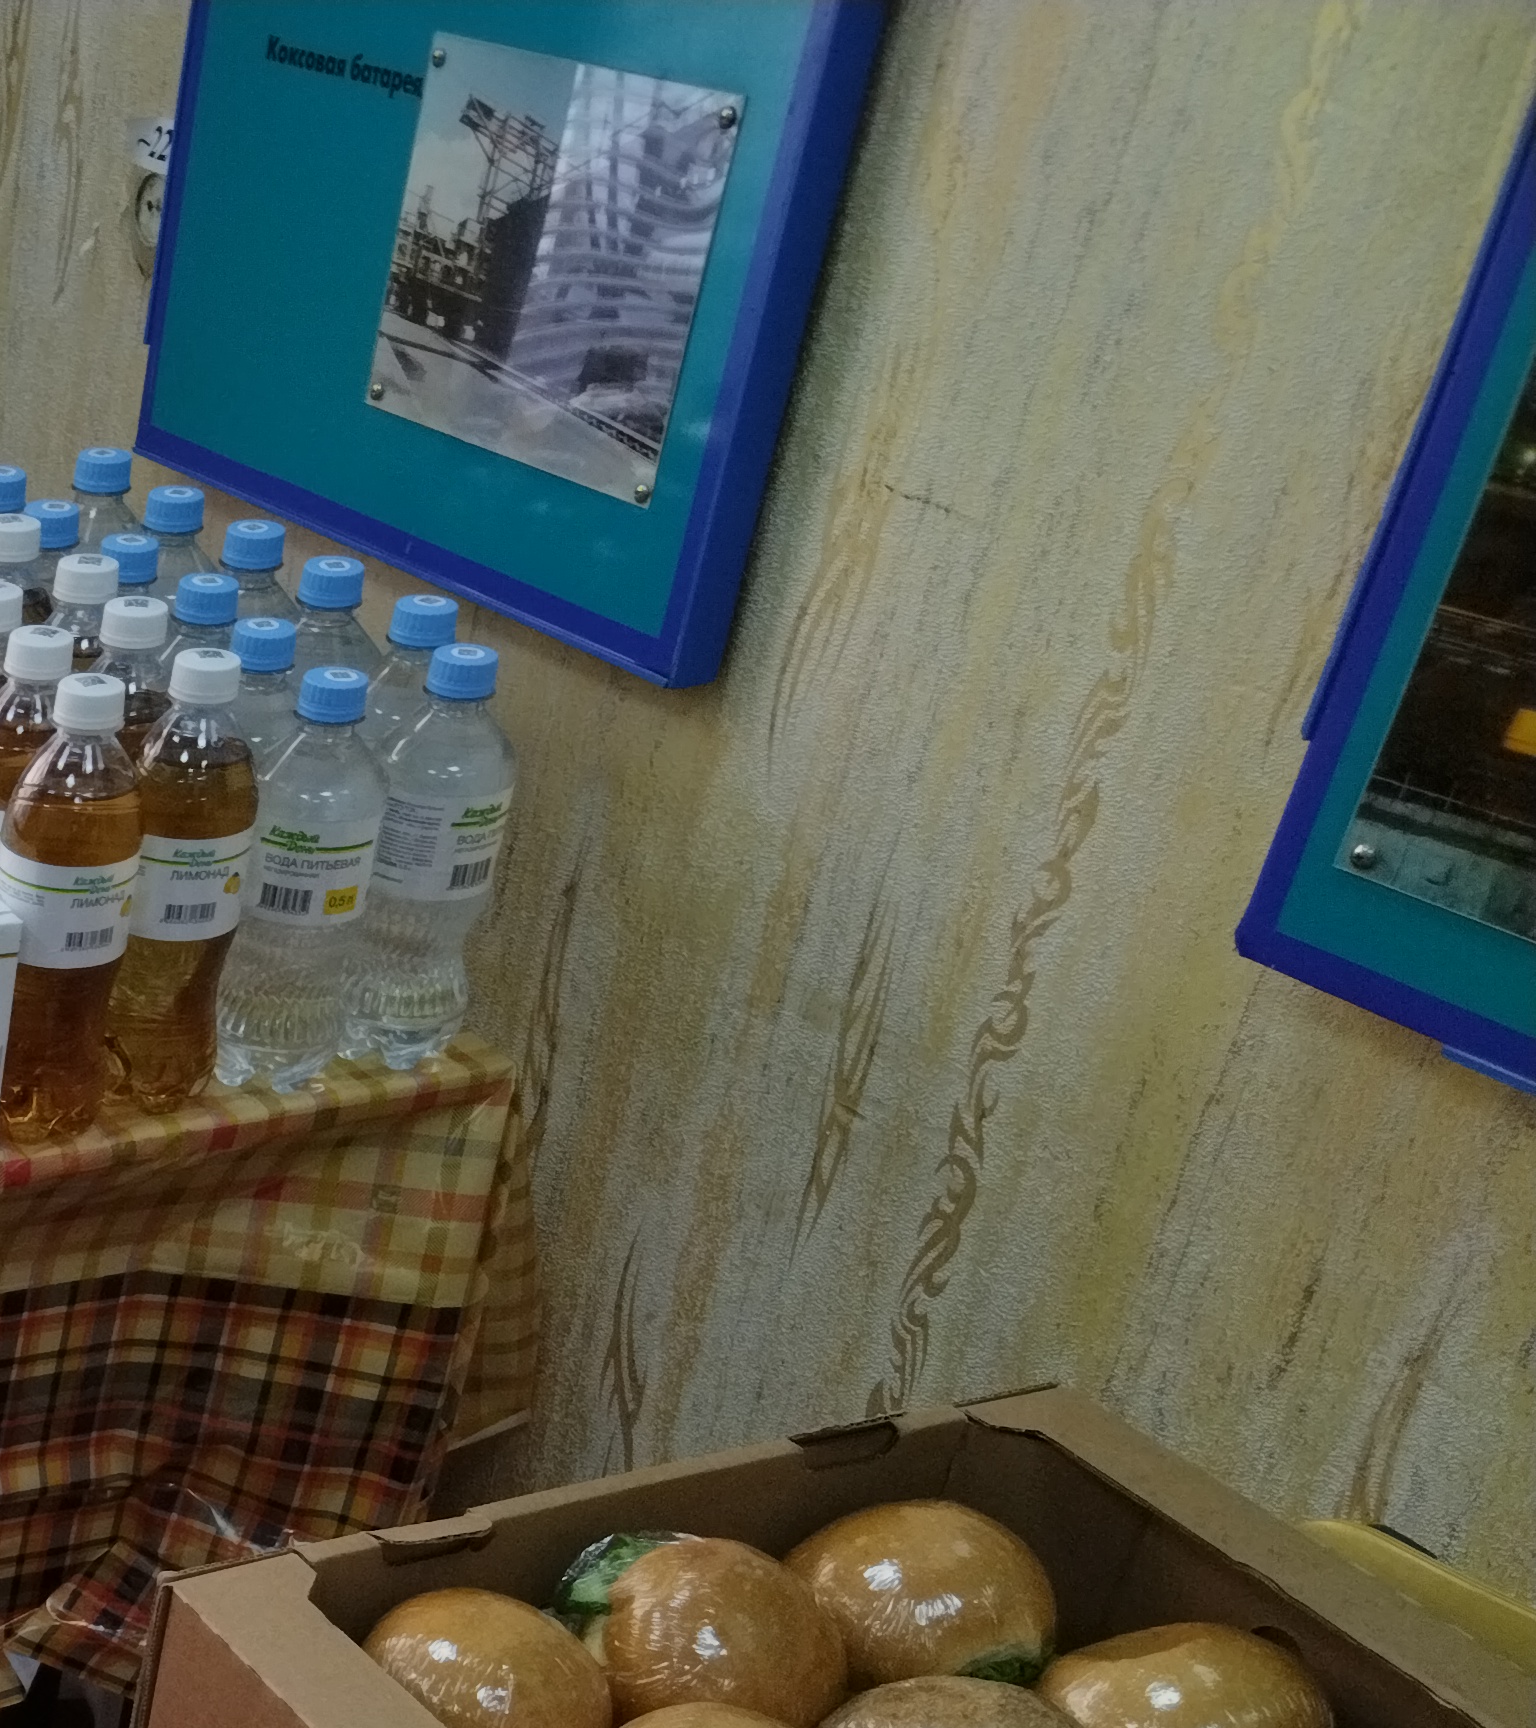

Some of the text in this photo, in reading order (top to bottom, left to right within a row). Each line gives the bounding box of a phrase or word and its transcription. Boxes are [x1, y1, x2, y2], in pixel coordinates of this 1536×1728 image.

[265, 34, 425, 99] Коксовая батарея
[265, 852, 362, 871] ВОДА ПИТЬЕВАЯ
[169, 866, 230, 882] ЛИМОНАД
[70, 890, 125, 910] ЛИМОНАД
